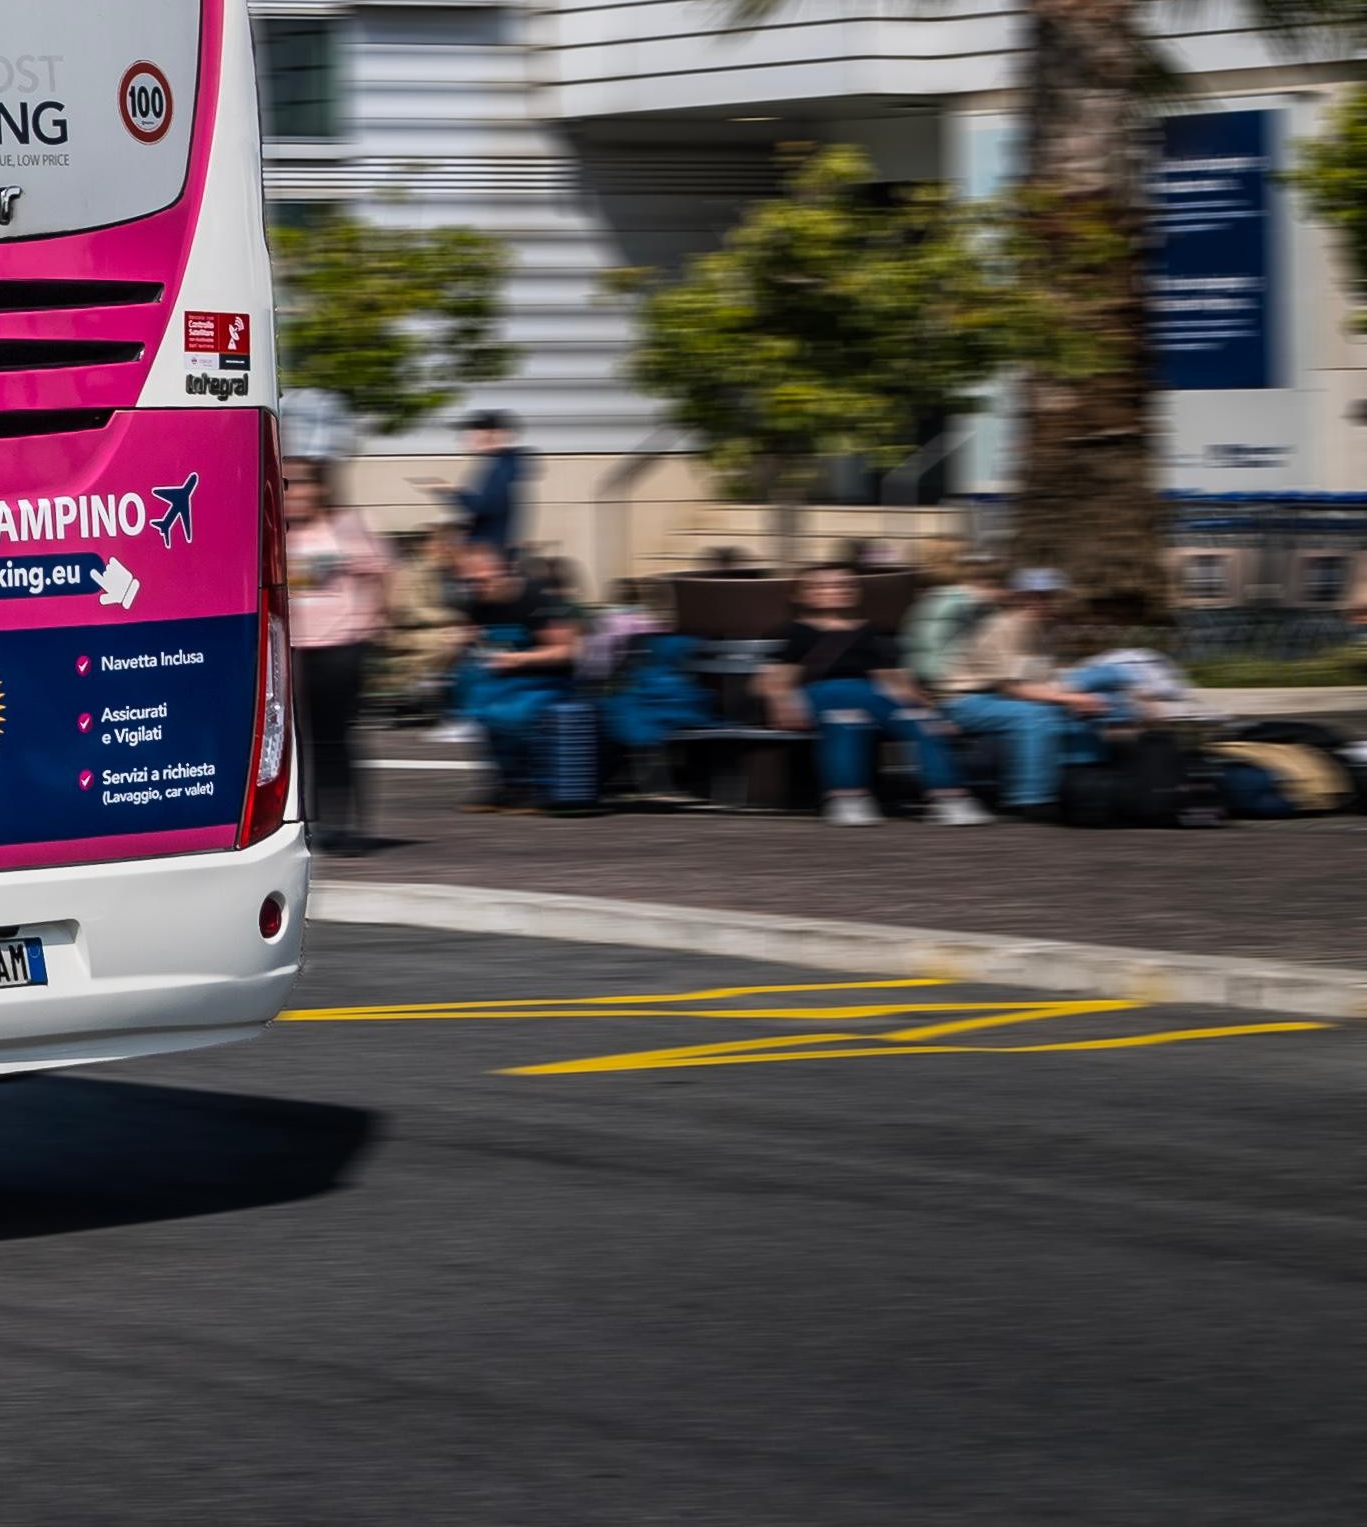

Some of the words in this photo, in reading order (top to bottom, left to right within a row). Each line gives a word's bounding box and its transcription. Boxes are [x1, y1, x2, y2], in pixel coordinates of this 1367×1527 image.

[128, 85, 164, 119] 100
[17, 154, 41, 166] LOW
[42, 153, 70, 166] PRICE
[100, 654, 158, 672] Navetta
[160, 648, 205, 666] Inclusa
[101, 701, 169, 723] Assicurati
[101, 733, 112, 745] e
[114, 724, 163, 747] Vigilati
[102, 766, 148, 785] Servizi
[150, 769, 160, 782] a
[162, 762, 216, 781] richiesta
[102, 787, 163, 806] (Lavaggio,
[165, 787, 183, 799] car
[184, 781, 214, 796] valet)
